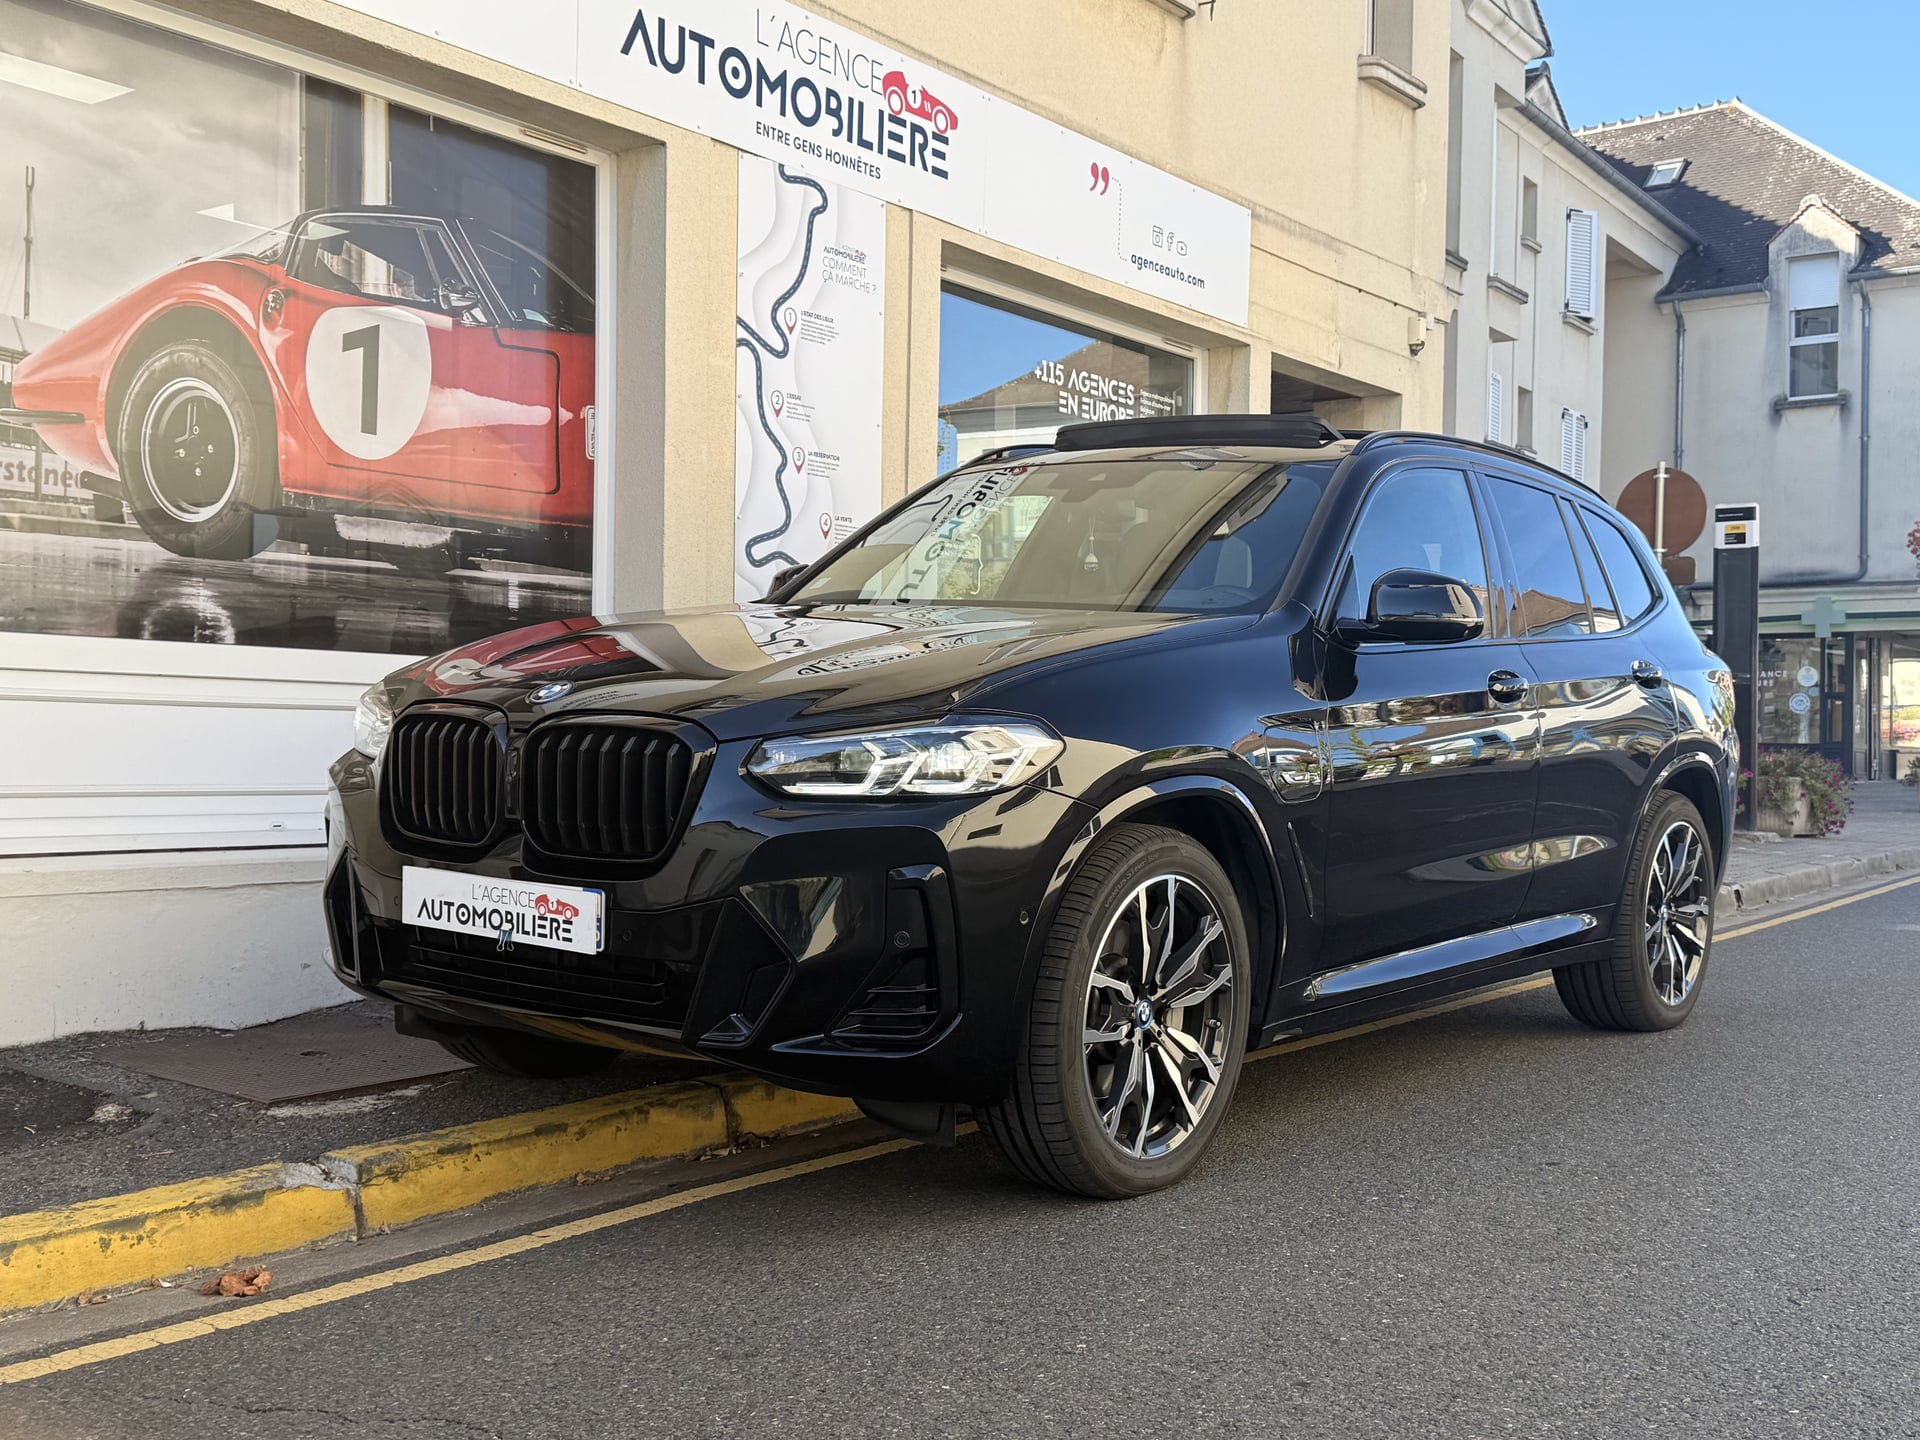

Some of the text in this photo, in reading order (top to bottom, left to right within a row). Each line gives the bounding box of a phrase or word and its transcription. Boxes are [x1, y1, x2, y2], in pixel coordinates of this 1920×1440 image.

[756, 8, 883, 96] L'AGENCE
[619, 8, 950, 181] AUTOMOBILIERE
[756, 121, 882, 181] ENTRE GENS HONNÊTES
[821, 269, 834, 283] ÇA
[835, 271, 871, 294] MARCHE
[822, 256, 868, 279] COMMENT
[1130, 252, 1206, 289] agenceauto.com
[341, 324, 381, 435] 1
[1034, 359, 1065, 386] +115
[1067, 368, 1135, 406] AGENCES
[775, 394, 781, 405] 2
[1058, 391, 1079, 417] EN
[796, 451, 802, 461] 3
[823, 518, 829, 527] 4
[471, 883, 536, 908] L'AGENCE
[417, 897, 573, 943] AUTOMOBILIERE
